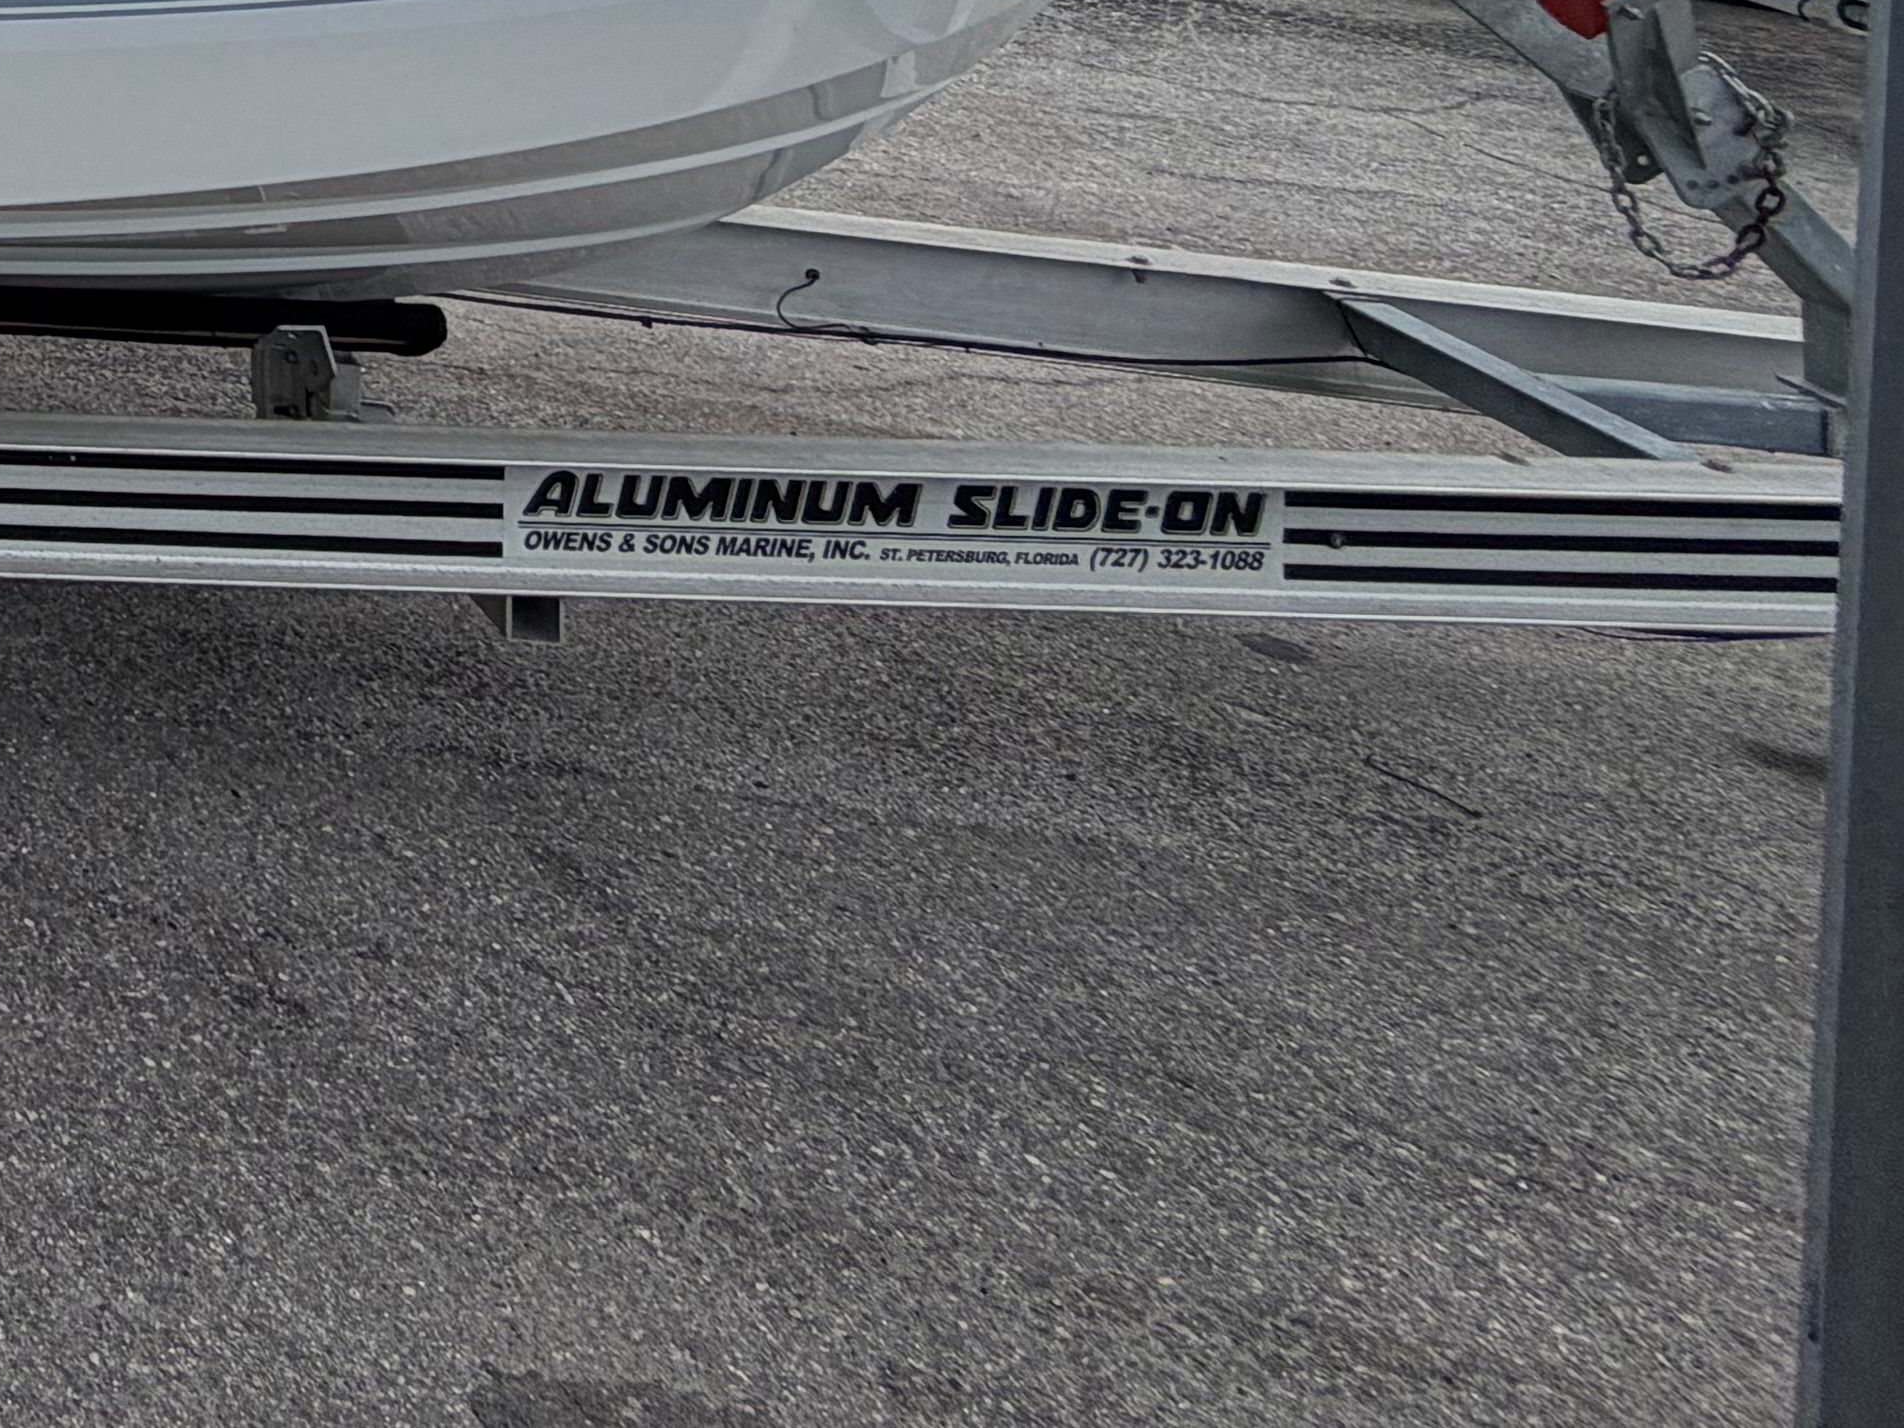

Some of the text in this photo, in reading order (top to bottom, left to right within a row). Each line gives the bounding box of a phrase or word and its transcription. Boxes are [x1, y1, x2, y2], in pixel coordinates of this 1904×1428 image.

[522, 470, 1267, 537] ALUMINUM SLIDE-ON
[524, 530, 1265, 572] OWENS & SONS MARINE, INC. ST. PETERSBURG, FLORIDA (727) 323-1088
